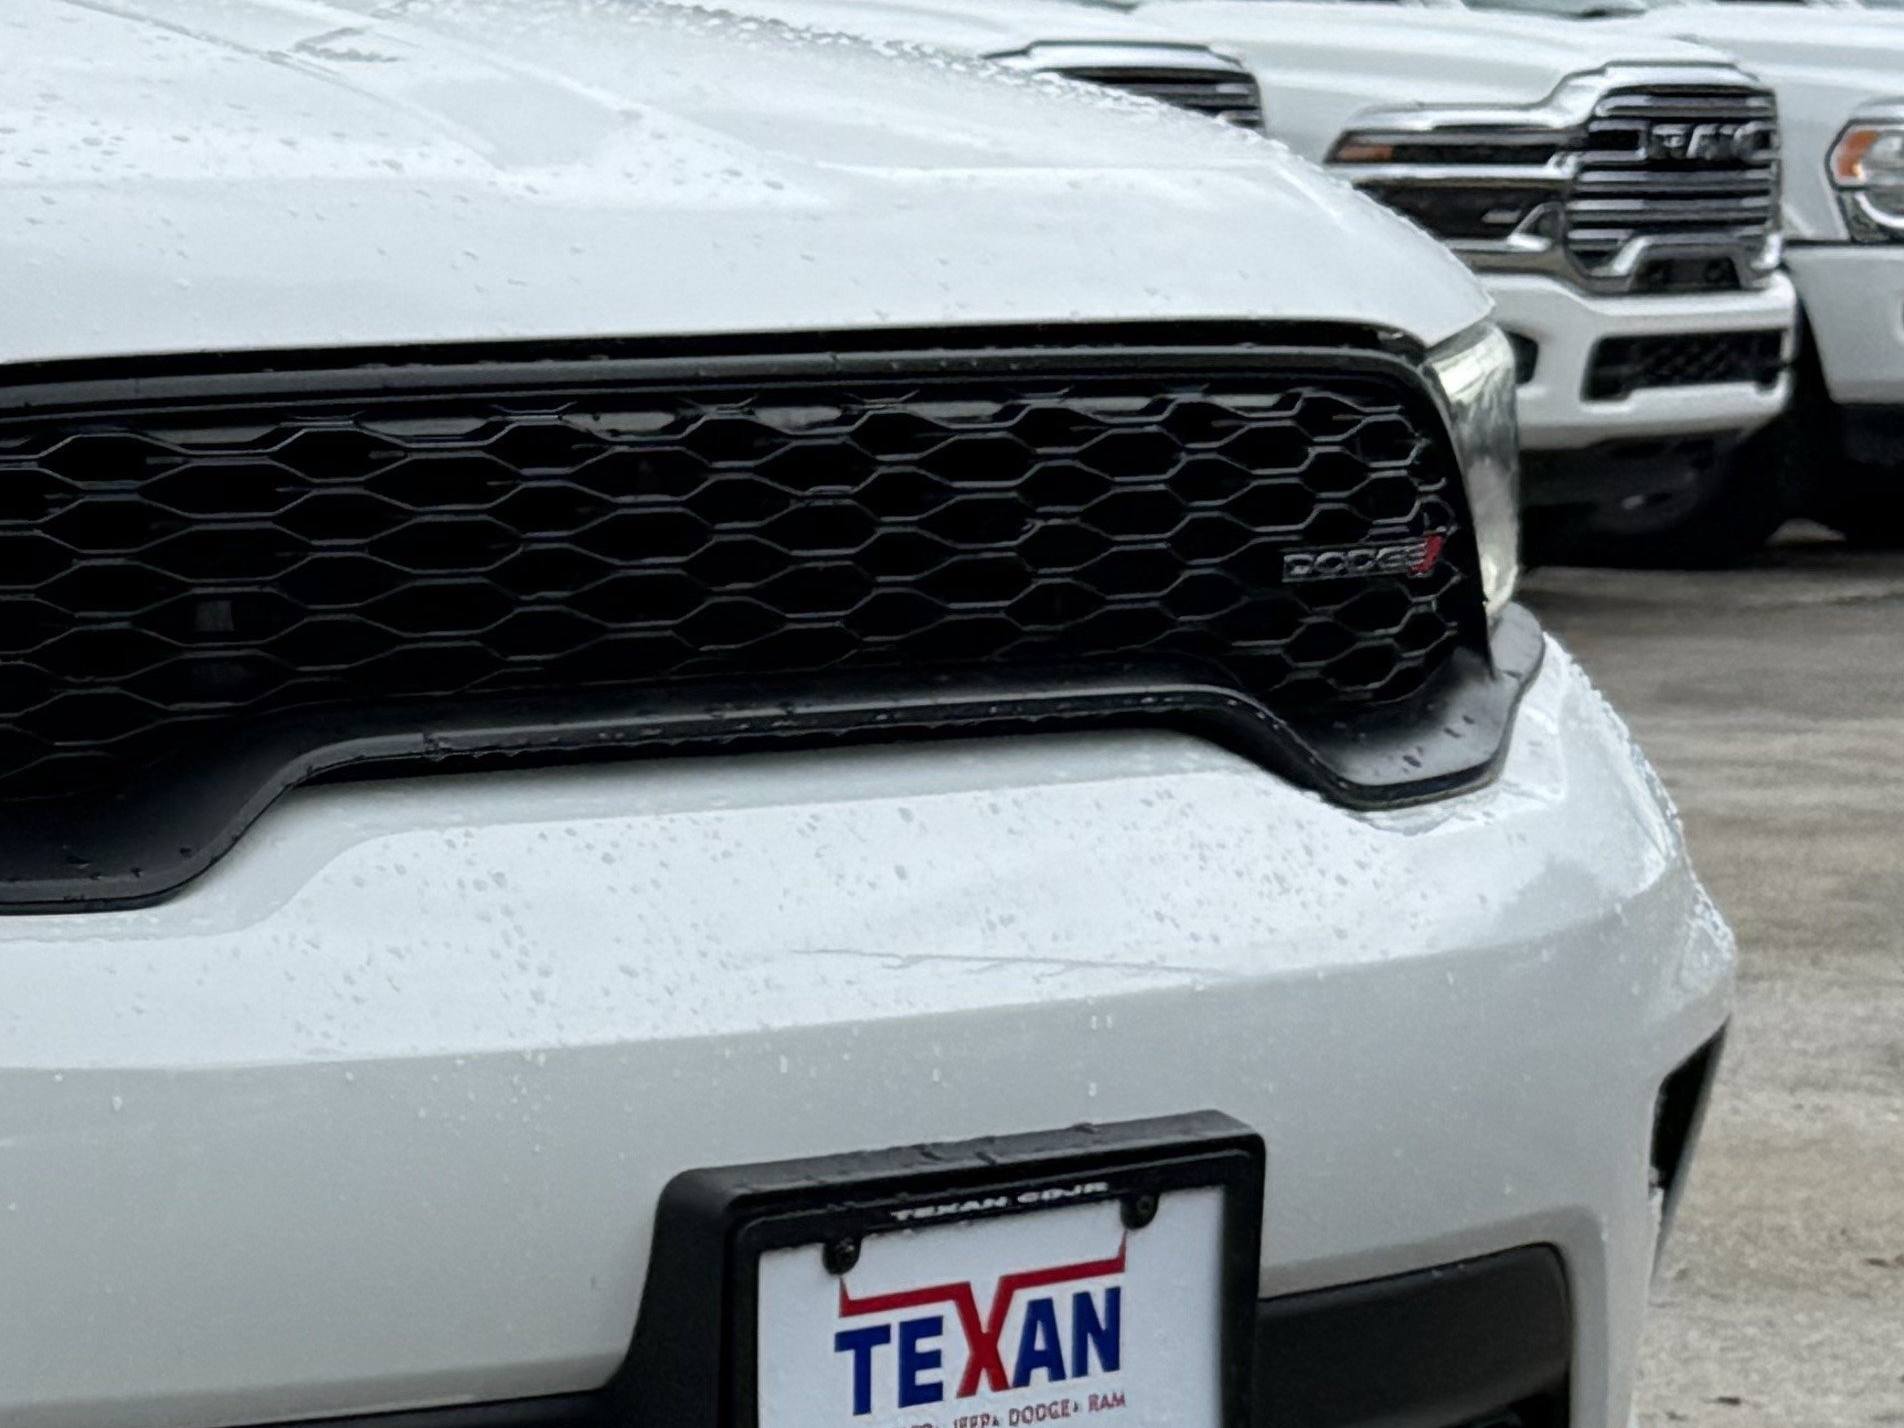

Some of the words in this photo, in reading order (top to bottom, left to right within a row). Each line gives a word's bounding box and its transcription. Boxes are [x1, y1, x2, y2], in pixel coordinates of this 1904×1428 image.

[1284, 543, 1426, 582] DODGE
[890, 1195, 1009, 1221] TEXAN
[834, 1256, 1126, 1416] TEXAN
[1088, 1389, 1127, 1412] RAM
